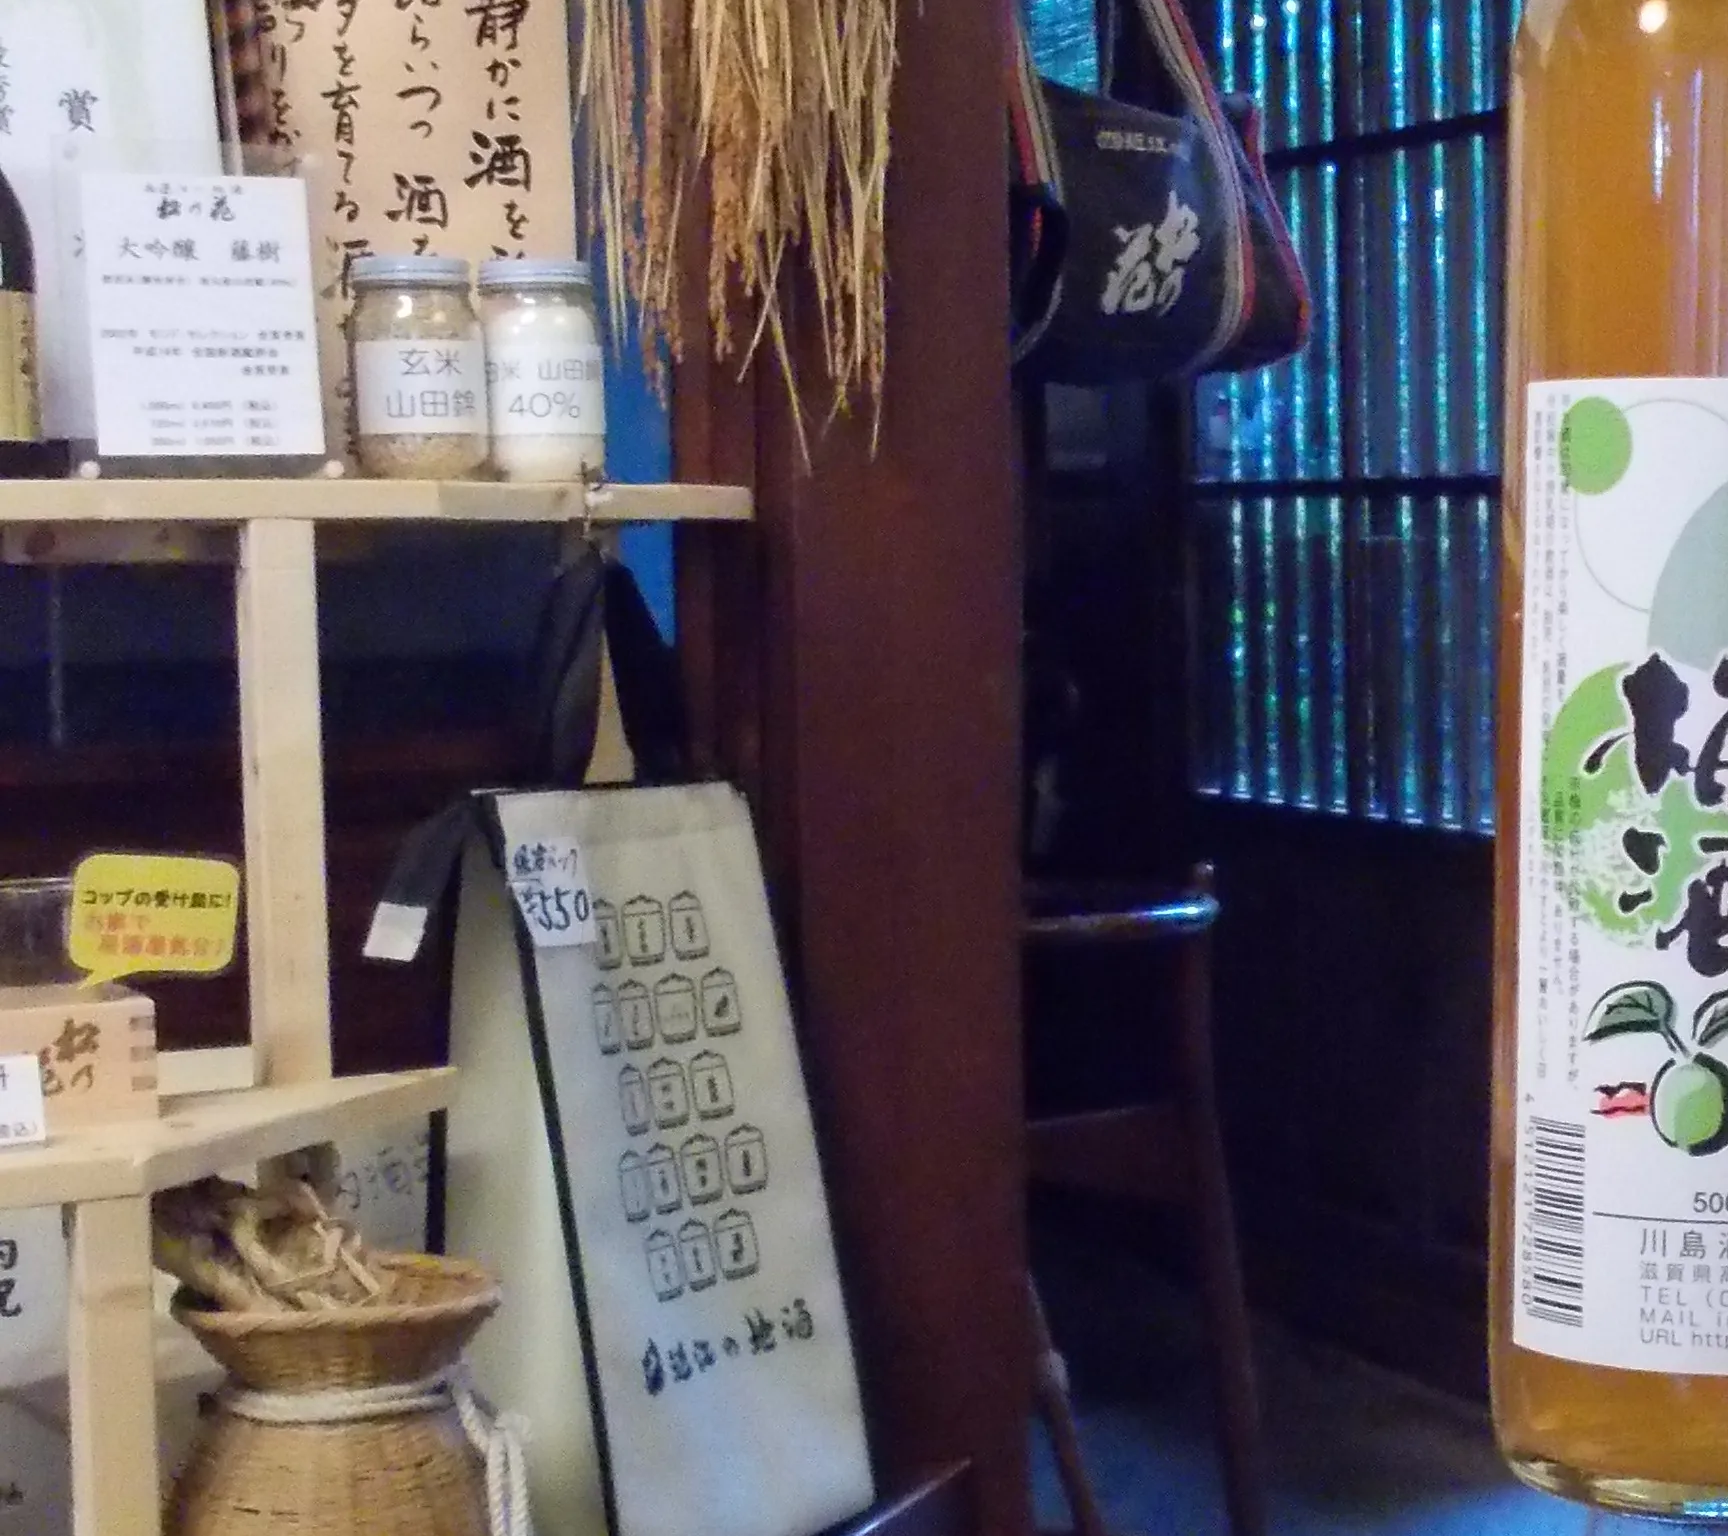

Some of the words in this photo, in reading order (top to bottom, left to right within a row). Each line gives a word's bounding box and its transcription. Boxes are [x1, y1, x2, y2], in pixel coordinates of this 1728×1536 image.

[399, 347, 462, 377] 玄米
[508, 392, 580, 418] 40%
[1640, 1285, 1689, 1306] TEL
[1640, 1308, 1700, 1327] MAIL
[1640, 1328, 1684, 1347] URL
